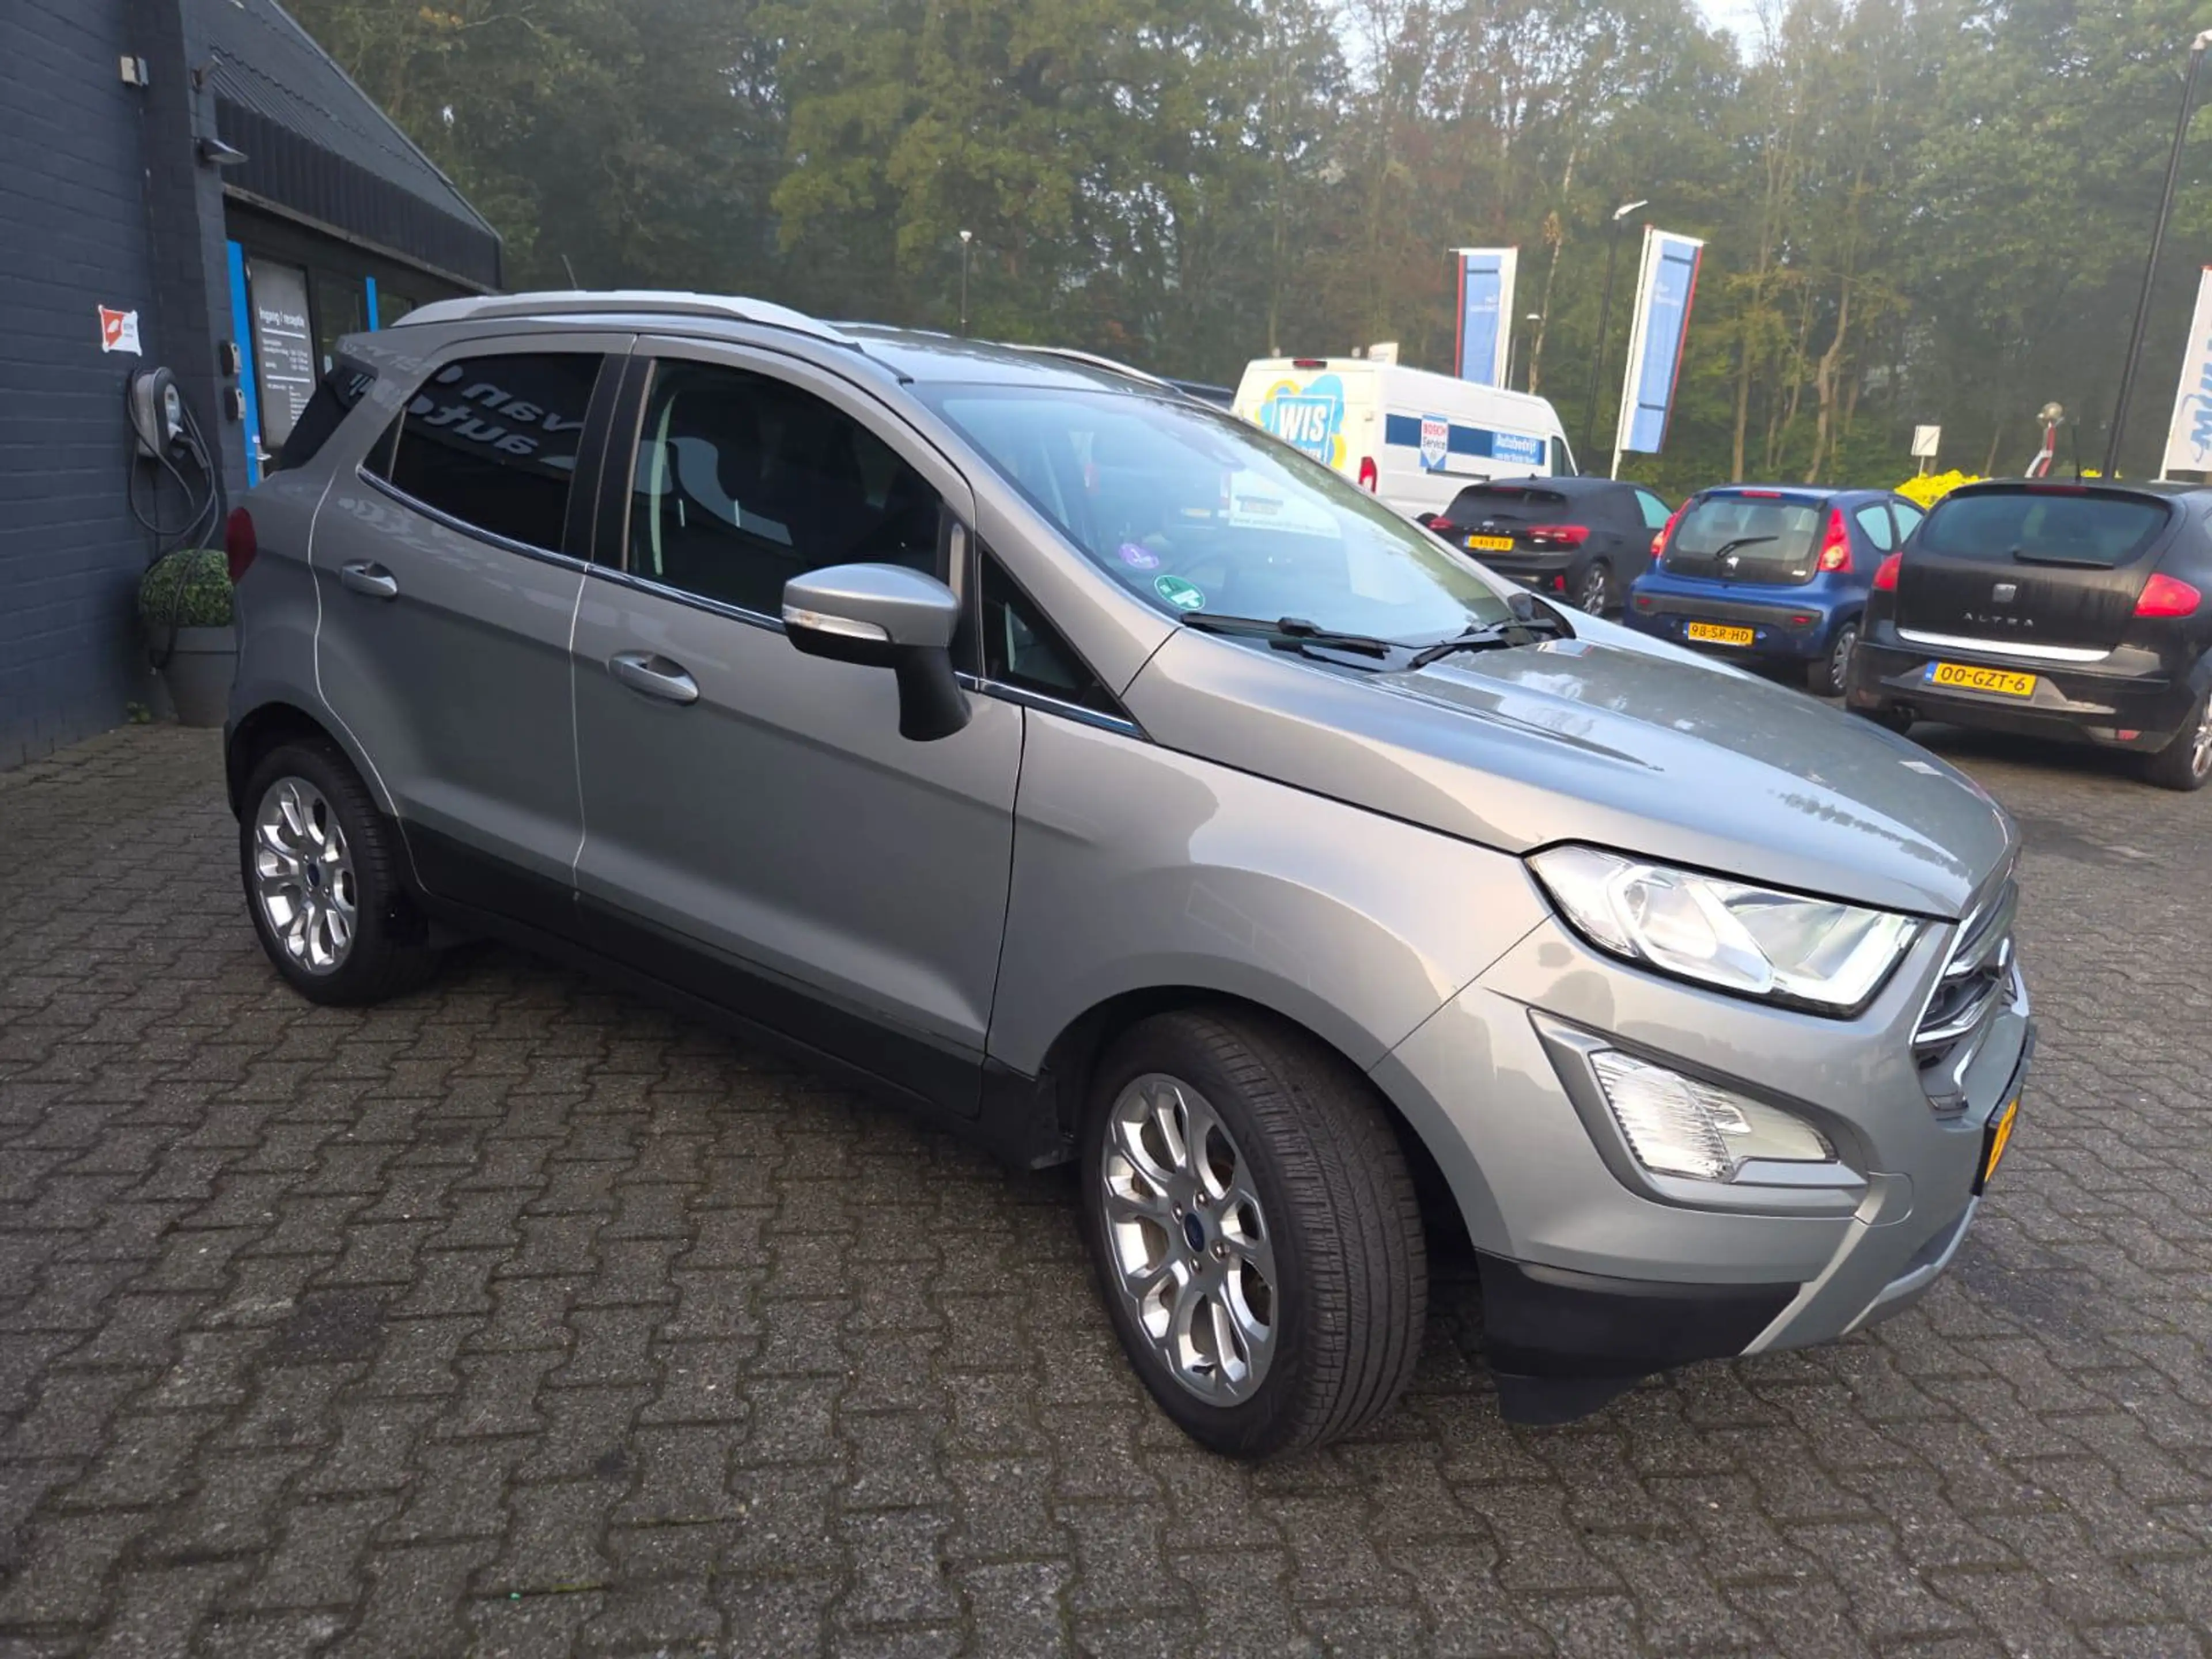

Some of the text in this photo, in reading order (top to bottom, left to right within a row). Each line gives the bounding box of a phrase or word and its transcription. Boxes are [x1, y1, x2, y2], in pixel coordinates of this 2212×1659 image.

[1279, 404, 1327, 442] WIS
[1423, 422, 1446, 437] BOSCH
[1422, 436, 1446, 450] Service
[1691, 624, 1749, 642] 98-SR-HD
[1940, 666, 2026, 691] 00-GZT-6
